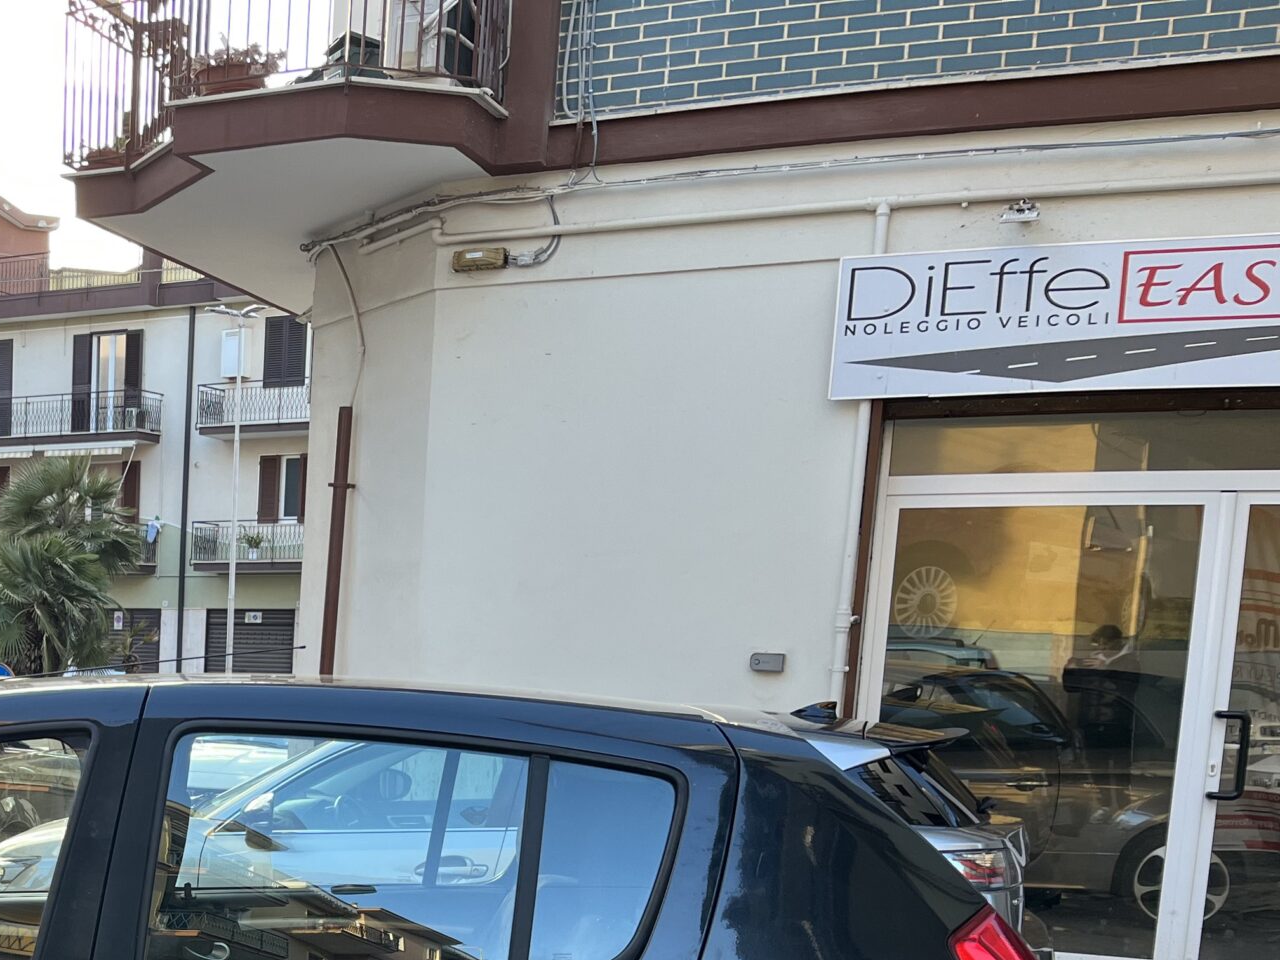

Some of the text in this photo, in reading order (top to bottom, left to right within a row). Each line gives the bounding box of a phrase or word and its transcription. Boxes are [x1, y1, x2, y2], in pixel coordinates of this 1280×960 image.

[846, 256, 1278, 321] DiEffe EAS
[843, 312, 1111, 337] NOLEGGIO VEICOLI
